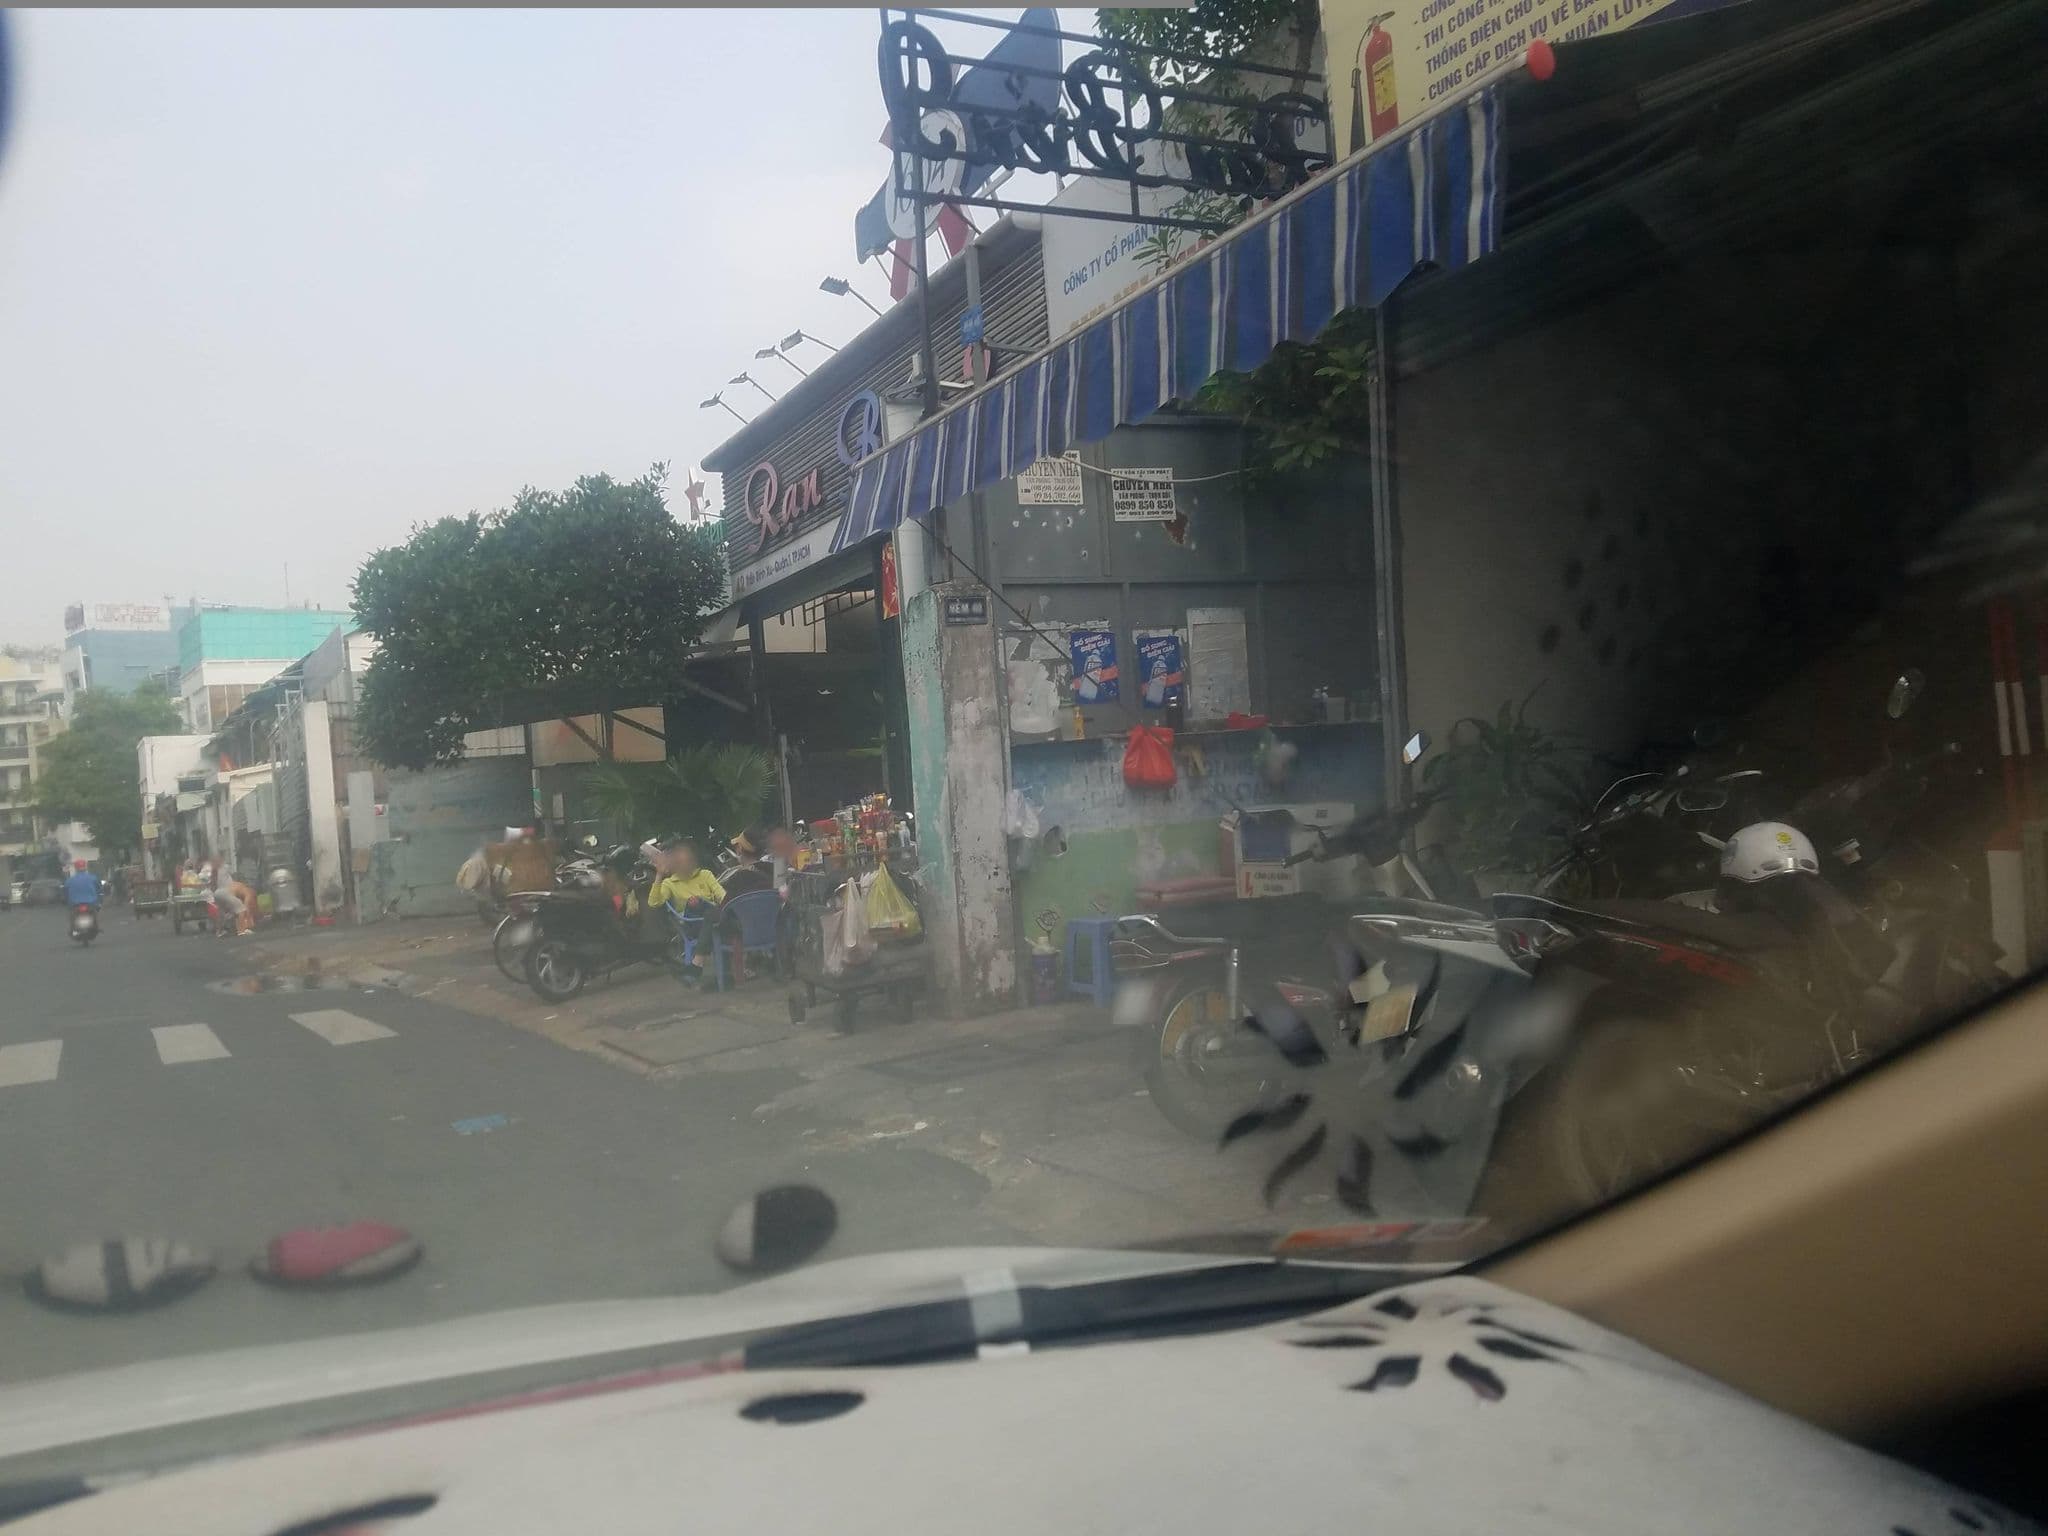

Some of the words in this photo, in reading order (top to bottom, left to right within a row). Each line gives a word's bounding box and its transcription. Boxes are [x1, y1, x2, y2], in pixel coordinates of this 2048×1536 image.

[1424, 24, 1444, 49] THI
[1448, 0, 1484, 33] CÔNG
[1505, 0, 1533, 25] CHO
[1428, 69, 1462, 100] CUNG
[1494, 29, 1526, 61] DỊCH
[1530, 16, 1548, 39] VỤ
[1063, 267, 1088, 295] CÔNG
[1089, 256, 1101, 277] TY
[1115, 500, 1136, 511] 0899
